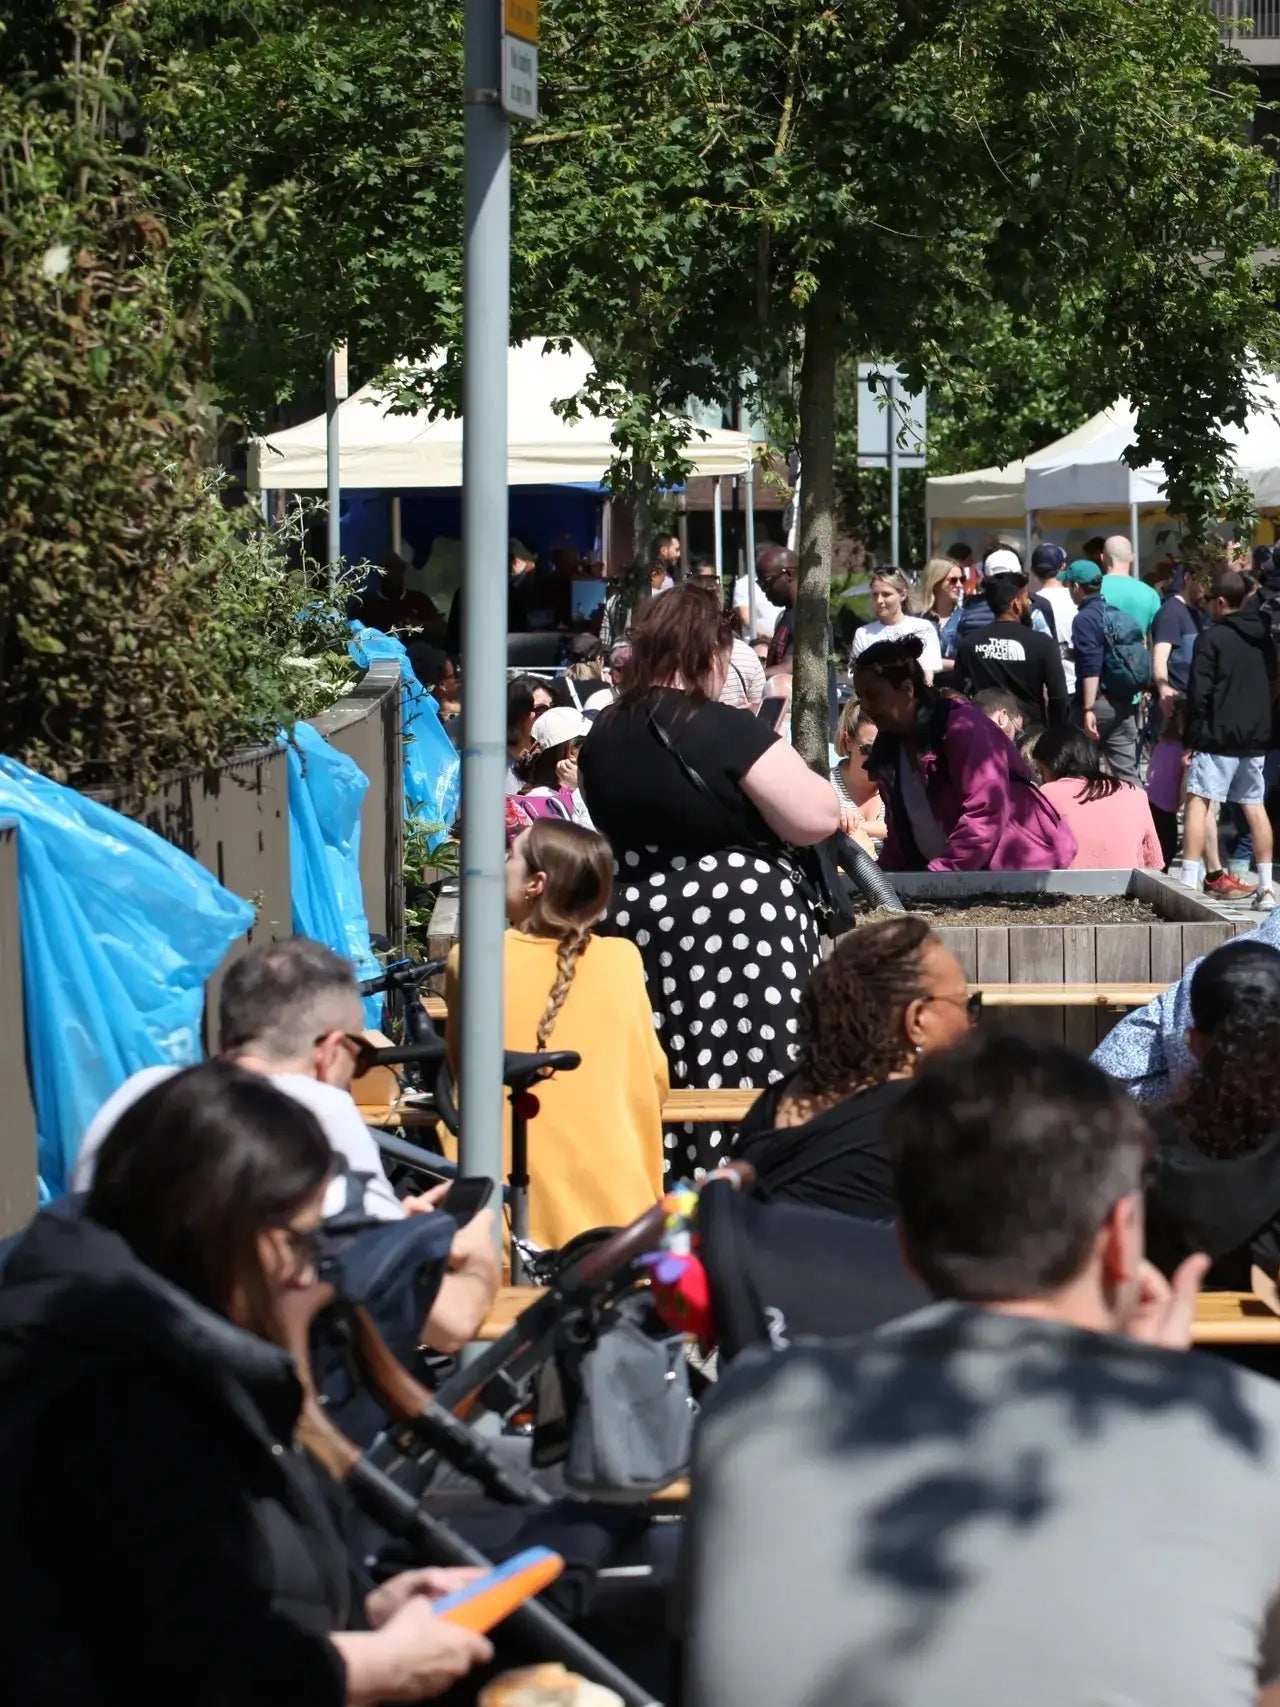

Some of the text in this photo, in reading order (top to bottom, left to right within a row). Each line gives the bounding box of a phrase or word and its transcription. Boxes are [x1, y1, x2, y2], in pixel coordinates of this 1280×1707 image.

[989, 637, 1008, 646] THE
[975, 644, 1008, 653] NORTH
[984, 651, 1009, 661] FACE
